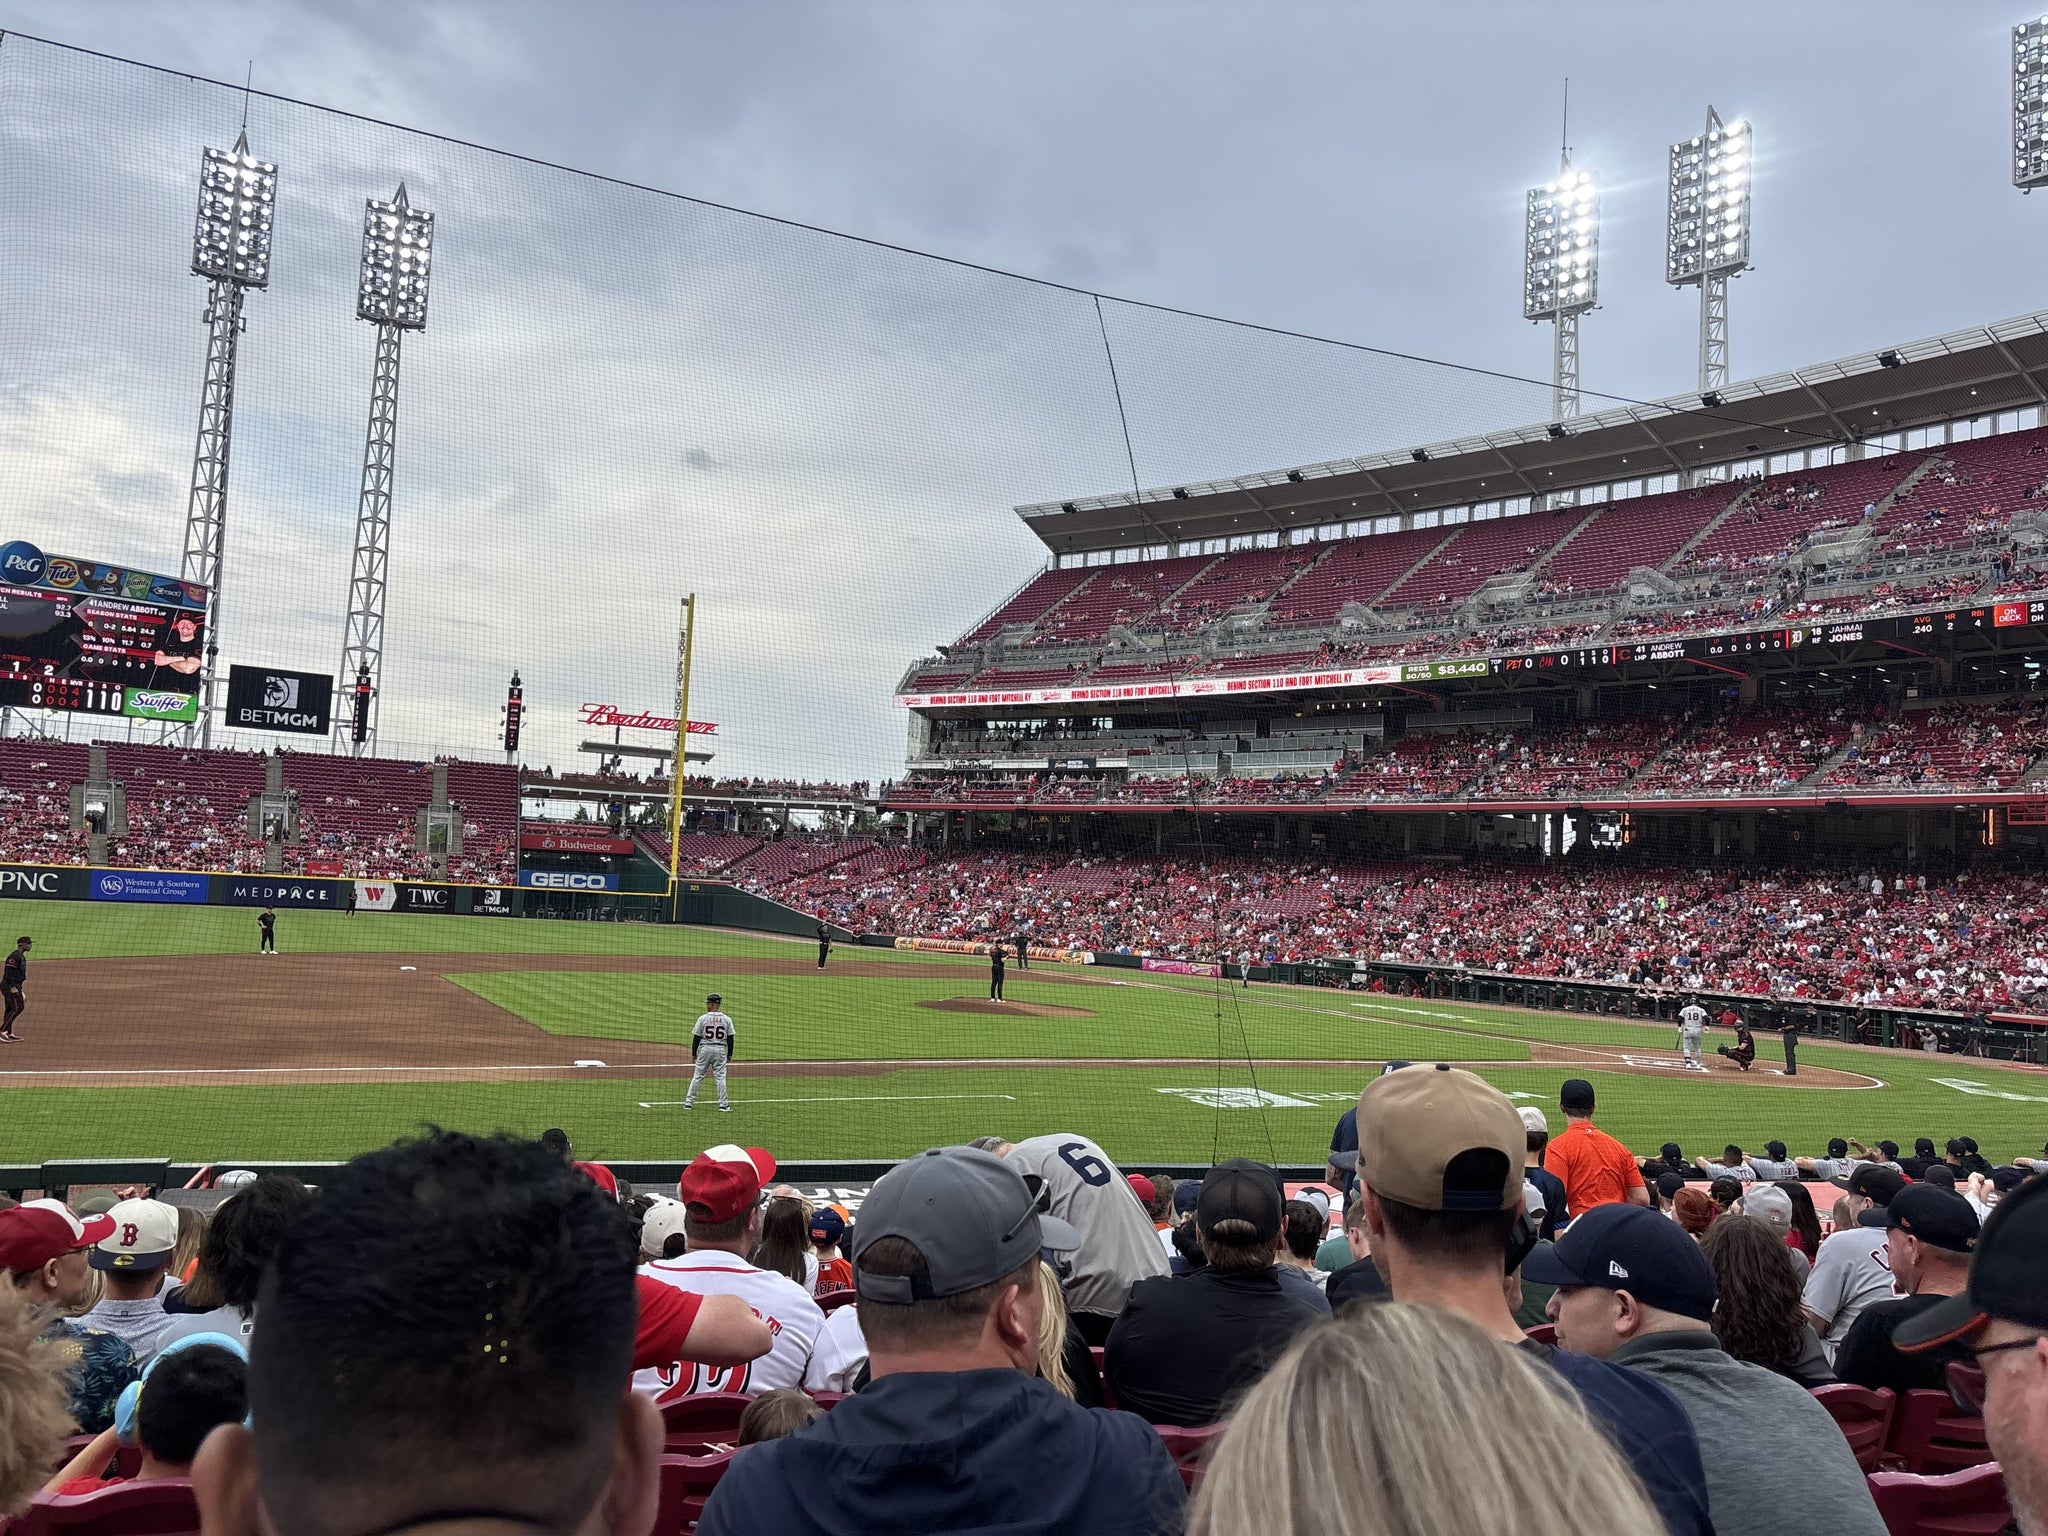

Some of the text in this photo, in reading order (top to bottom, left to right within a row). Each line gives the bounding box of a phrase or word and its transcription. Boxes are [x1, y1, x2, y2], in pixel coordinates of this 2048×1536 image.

[4, 554, 42, 572] P&G
[49, 564, 77, 581] Tide
[11, 589, 43, 598] RESULTS
[55, 603, 72, 611] 92.7
[86, 608, 115, 617] SEASON
[88, 599, 97, 607] 41
[97, 601, 130, 611] ANDREW
[130, 606, 159, 615] ABBOTT
[2003, 607, 2017, 615] ON
[2030, 602, 2045, 613] 25
[54, 610, 72, 618] 93.3
[1913, 609, 1985, 624] AVG HR RBI
[1999, 613, 2022, 623] DECK
[2031, 614, 2044, 622] DH
[1811, 623, 1863, 636] 18 JAHMAI
[1912, 619, 1982, 634] .240 2 4
[1812, 632, 1863, 645] RF JONES
[1635, 642, 1683, 653] 41 ANDREW
[1709, 645, 1723, 654] 0.0
[1730, 644, 1738, 652] 0
[1759, 641, 1766, 649] 0
[1773, 640, 1780, 648] 0
[39, 658, 61, 666] TOTAL
[1505, 654, 1569, 670] DET 0 CIN 0
[1579, 655, 1609, 666] 1 1 0
[1634, 649, 1685, 662] LHP ABBOTT
[12, 661, 54, 676] 1 2
[1408, 662, 1486, 676] REDS $8,440
[1493, 665, 1499, 673] 1
[1227, 680, 1247, 692] BEHIND
[1248, 679, 1271, 690] SECTION
[1272, 678, 1284, 689] 110
[1285, 677, 1298, 688] AND
[1299, 675, 1313, 687] FORT
[1314, 673, 1343, 685] MITCHELL
[1344, 672, 1353, 684] KY
[1406, 672, 1432, 680] 50/50
[33, 682, 80, 696] 0 0 0 4
[1090, 688, 1111, 699] SECTION
[1148, 685, 1172, 696] MITCHELL
[31, 694, 79, 708] 0 0 0 4
[87, 689, 122, 711] 1 1 0
[131, 691, 187, 713] Swiffer
[947, 695, 967, 704] SECTION
[239, 707, 318, 728] BETMGM
[951, 759, 992, 770] handlebar
[559, 839, 612, 851] Budweiser
[0, 870, 59, 893] PNC
[125, 878, 156, 887] Western
[157, 879, 165, 887] &
[166, 879, 200, 888] Southern
[530, 872, 606, 889] GEICO
[125, 886, 187, 896] Financial Group
[407, 888, 448, 905] TWC
[473, 904, 510, 914] BETMGM
[918, 939, 947, 950] GORILLA
[1687, 1012, 1699, 1021] 18
[704, 1025, 725, 1040] 56
[1057, 1142, 1111, 1187] 6
[119, 1222, 138, 1247] B
